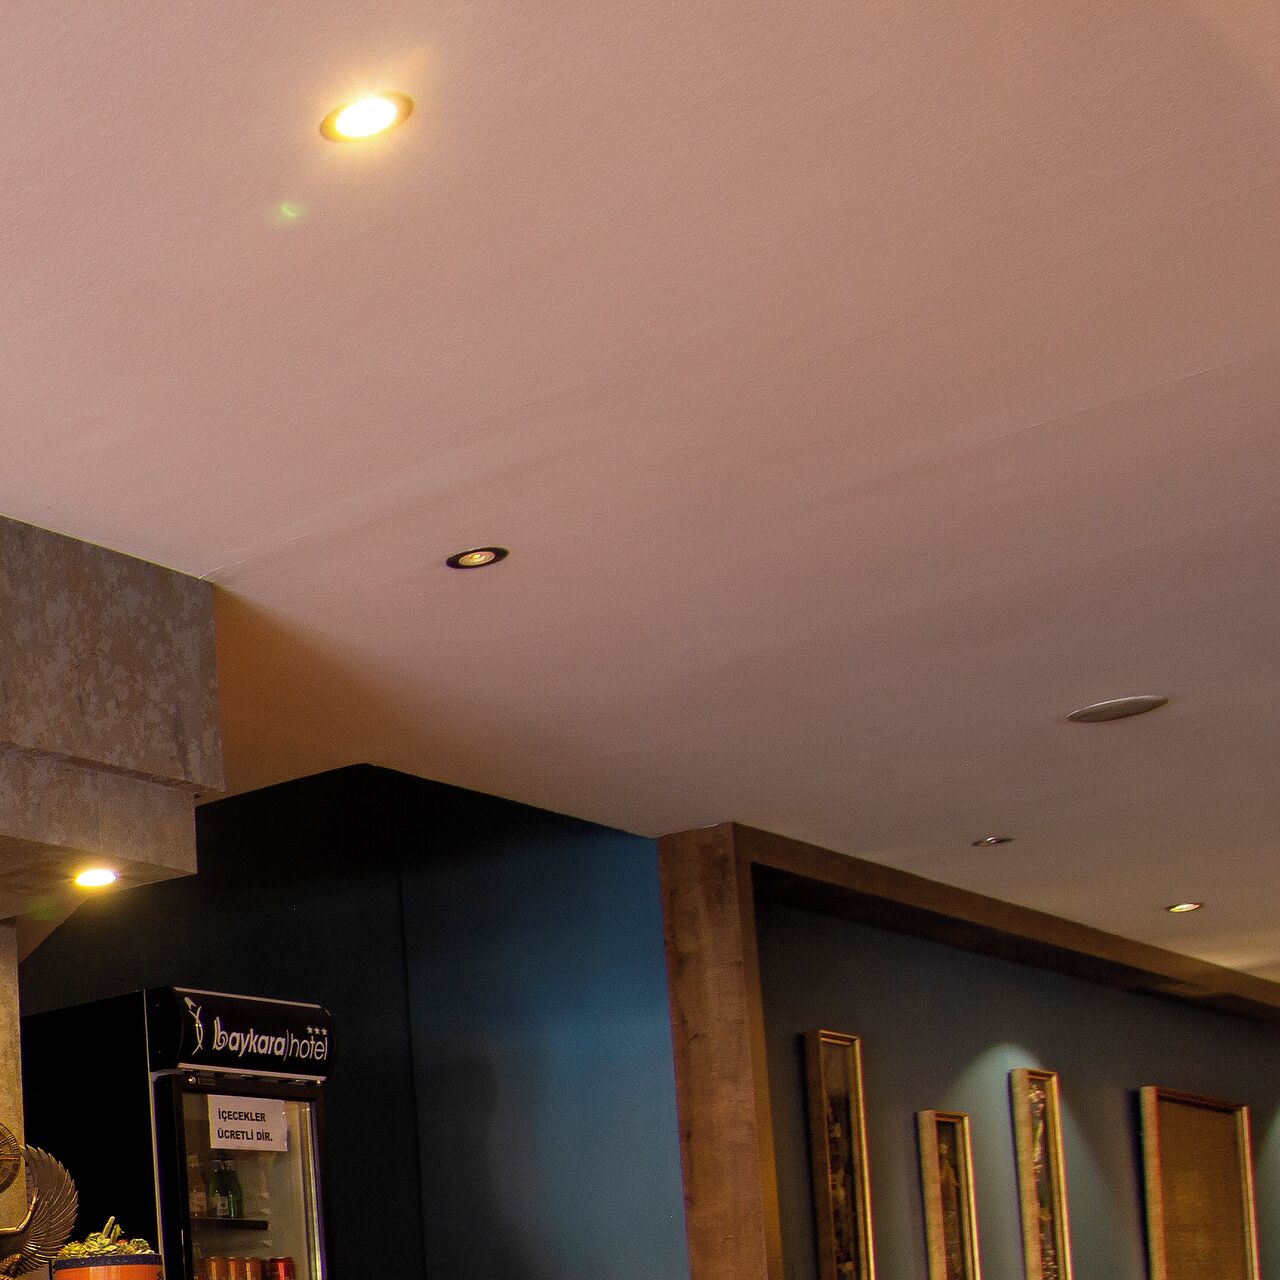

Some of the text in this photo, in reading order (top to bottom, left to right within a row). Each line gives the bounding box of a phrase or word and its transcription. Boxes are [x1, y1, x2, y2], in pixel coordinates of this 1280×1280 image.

[212, 1016, 328, 1061] baykara hotel
[218, 1107, 266, 1123] İÇECEKLER
[217, 1127, 273, 1142] ÜCRETLİ DİR.
